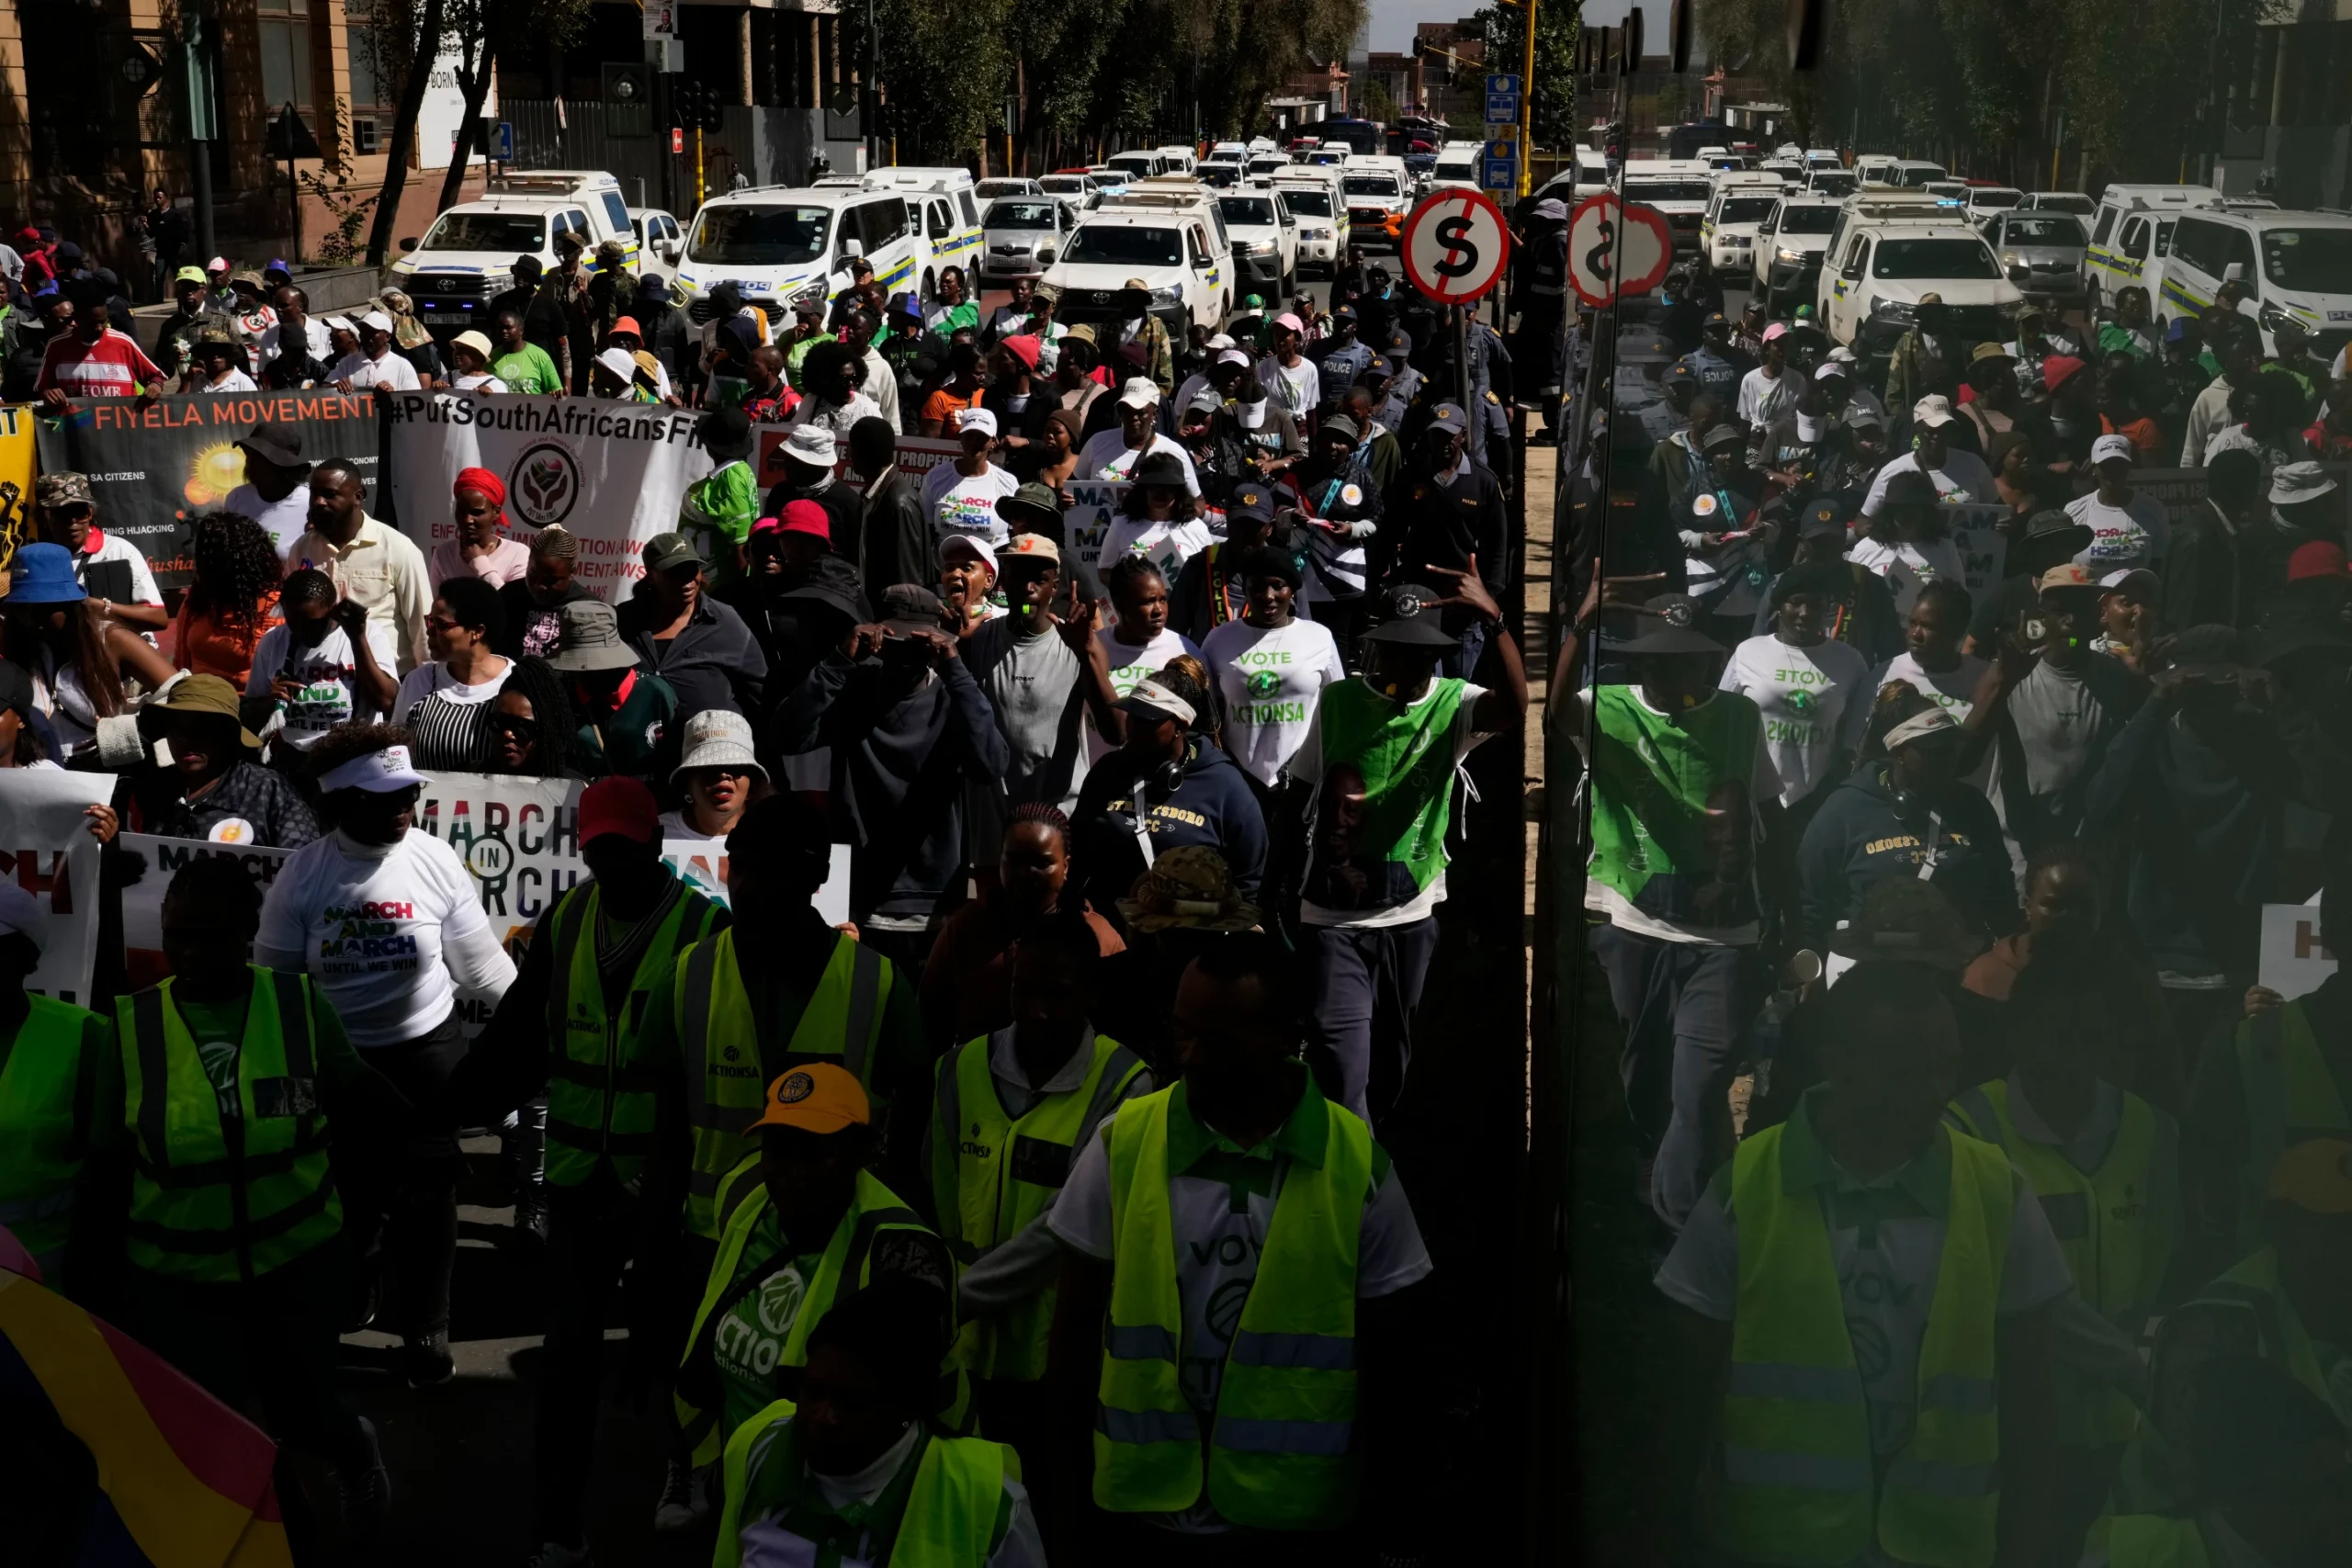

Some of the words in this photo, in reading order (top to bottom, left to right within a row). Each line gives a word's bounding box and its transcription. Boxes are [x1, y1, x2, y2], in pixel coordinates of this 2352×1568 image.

[431, 72, 454, 88] BORN
[1433, 216, 1479, 278] S
[1323, 359, 1352, 375] POLICE
[95, 402, 203, 430] FIYELA
[213, 395, 376, 425] MOVEMENT
[390, 395, 706, 450] #PutSouthAfricansFi
[345, 456, 379, 465] CONOMY
[900, 450, 963, 468] PROPERT
[90, 473, 103, 482] SA
[104, 471, 145, 481] CITIZENS
[946, 495, 992, 508] MARCH
[953, 504, 982, 514] AND
[940, 511, 990, 525] MARCH
[102, 527, 125, 536] DING
[127, 524, 175, 535] HIJACKING
[1019, 539, 1035, 551] J
[1240, 650, 1293, 667] VOTE
[297, 663, 356, 683] ARCH
[294, 683, 340, 702] AND
[287, 702, 348, 719] ARCH
[1231, 701, 1305, 725] ACTIONSA
[311, 720, 326, 731] WE
[1106, 799, 1205, 827] STRTSBORO
[410, 798, 580, 858] MARCH
[480, 846, 500, 868] IN
[323, 901, 413, 925] MARCH
[338, 919, 397, 940] AND
[321, 934, 417, 958] MARCH
[323, 961, 365, 974] UNTIL
[368, 960, 388, 972] WE
[392, 957, 418, 971] WIN
[567, 1016, 602, 1034] ACTIONSA
[707, 1063, 760, 1079] ACTIONSA
[716, 1314, 780, 1376] CTIO
